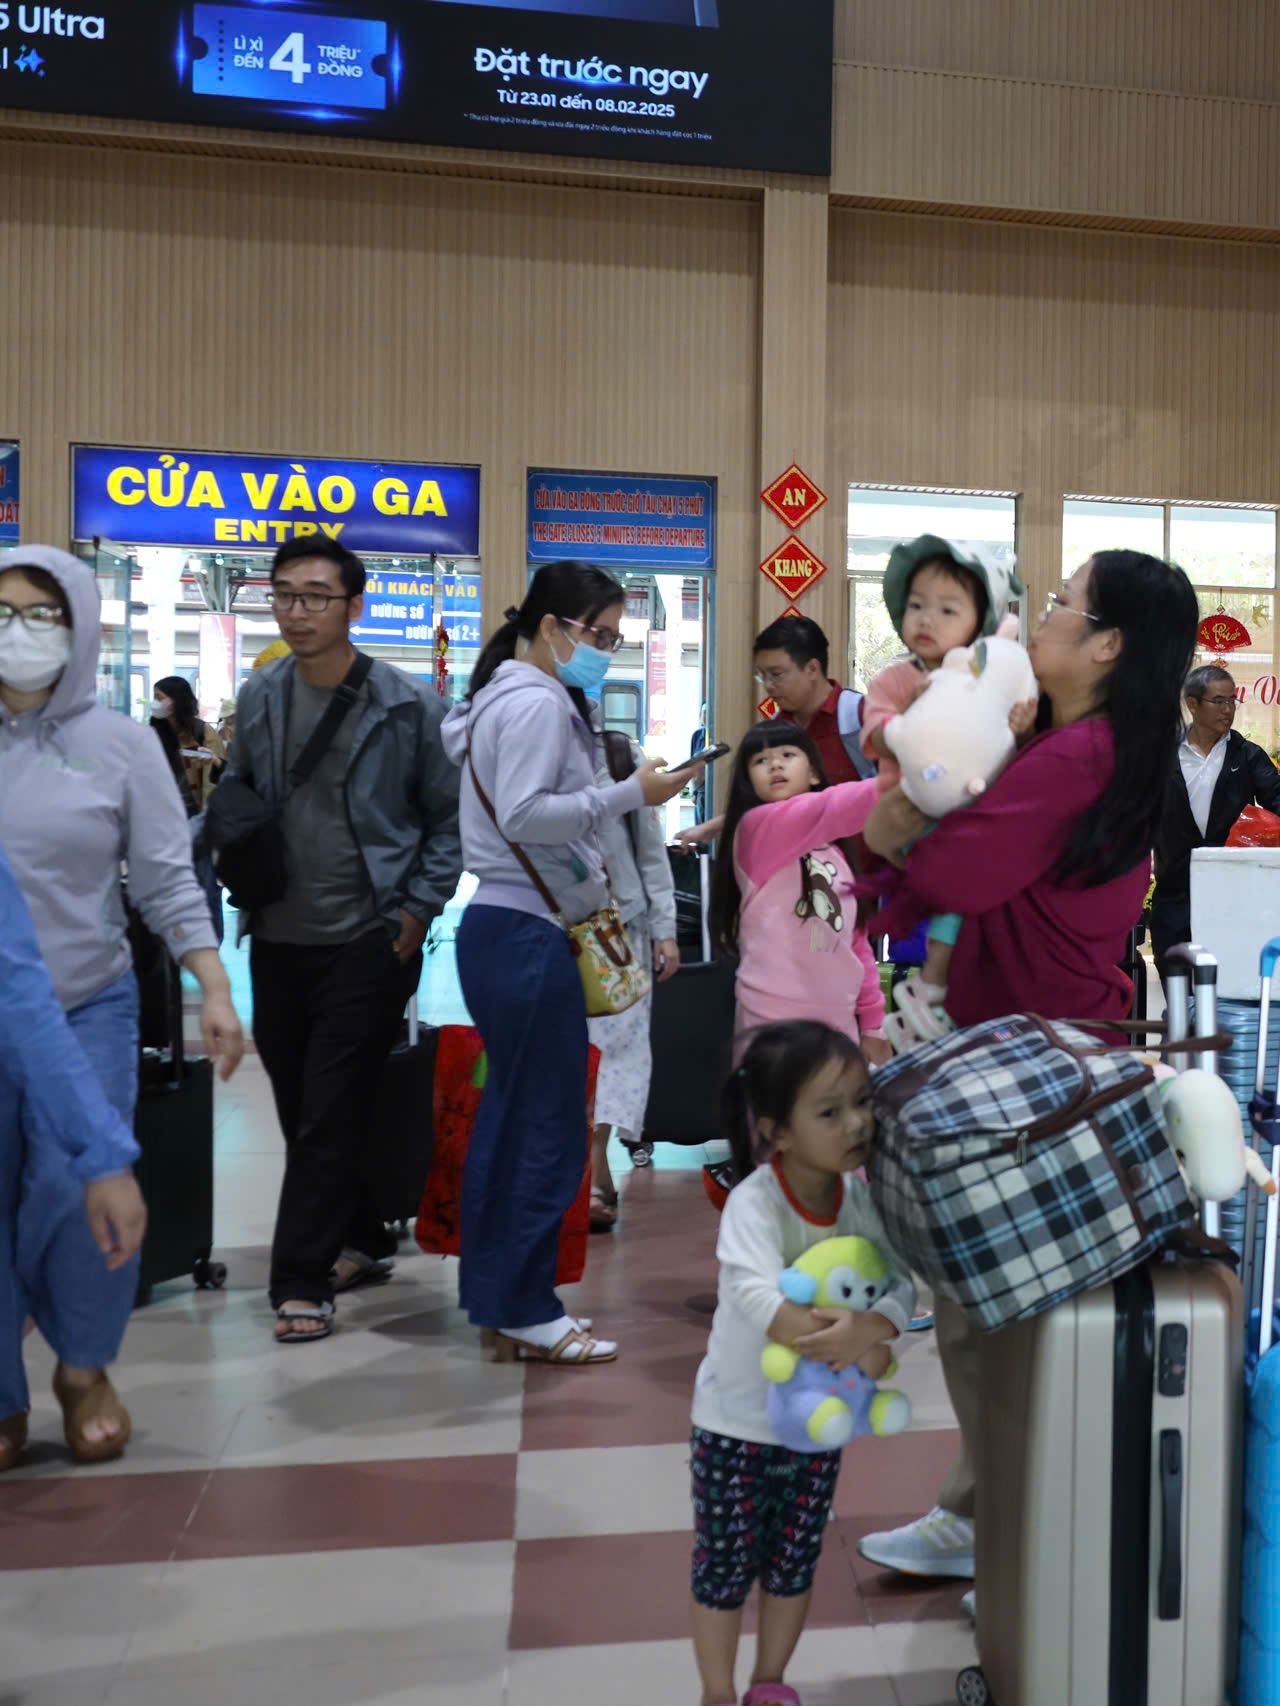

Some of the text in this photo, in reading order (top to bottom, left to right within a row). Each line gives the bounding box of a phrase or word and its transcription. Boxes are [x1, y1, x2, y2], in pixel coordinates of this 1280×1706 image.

[18, 6, 105, 39] Ultra
[234, 34, 264, 53] LÌ XÌ
[233, 52, 264, 70] ĐẾN
[269, 32, 311, 84] 4
[317, 59, 363, 78] ĐỒNG
[474, 47, 709, 99] Đặt trước ngay
[497, 89, 676, 117] Từ 23.01 đến 08.02.2025
[106, 454, 448, 518] CỬA VÀO GA
[780, 488, 807, 506] AN
[568, 490, 578, 511] GA
[214, 517, 345, 543] ENTRY
[533, 521, 706, 548] THE GATE CLOSES 5 MINUTES BEFORE DEPARTURE
[774, 559, 812, 577] KHANG
[370, 602, 426, 620] ĐƯỜNG SỐ
